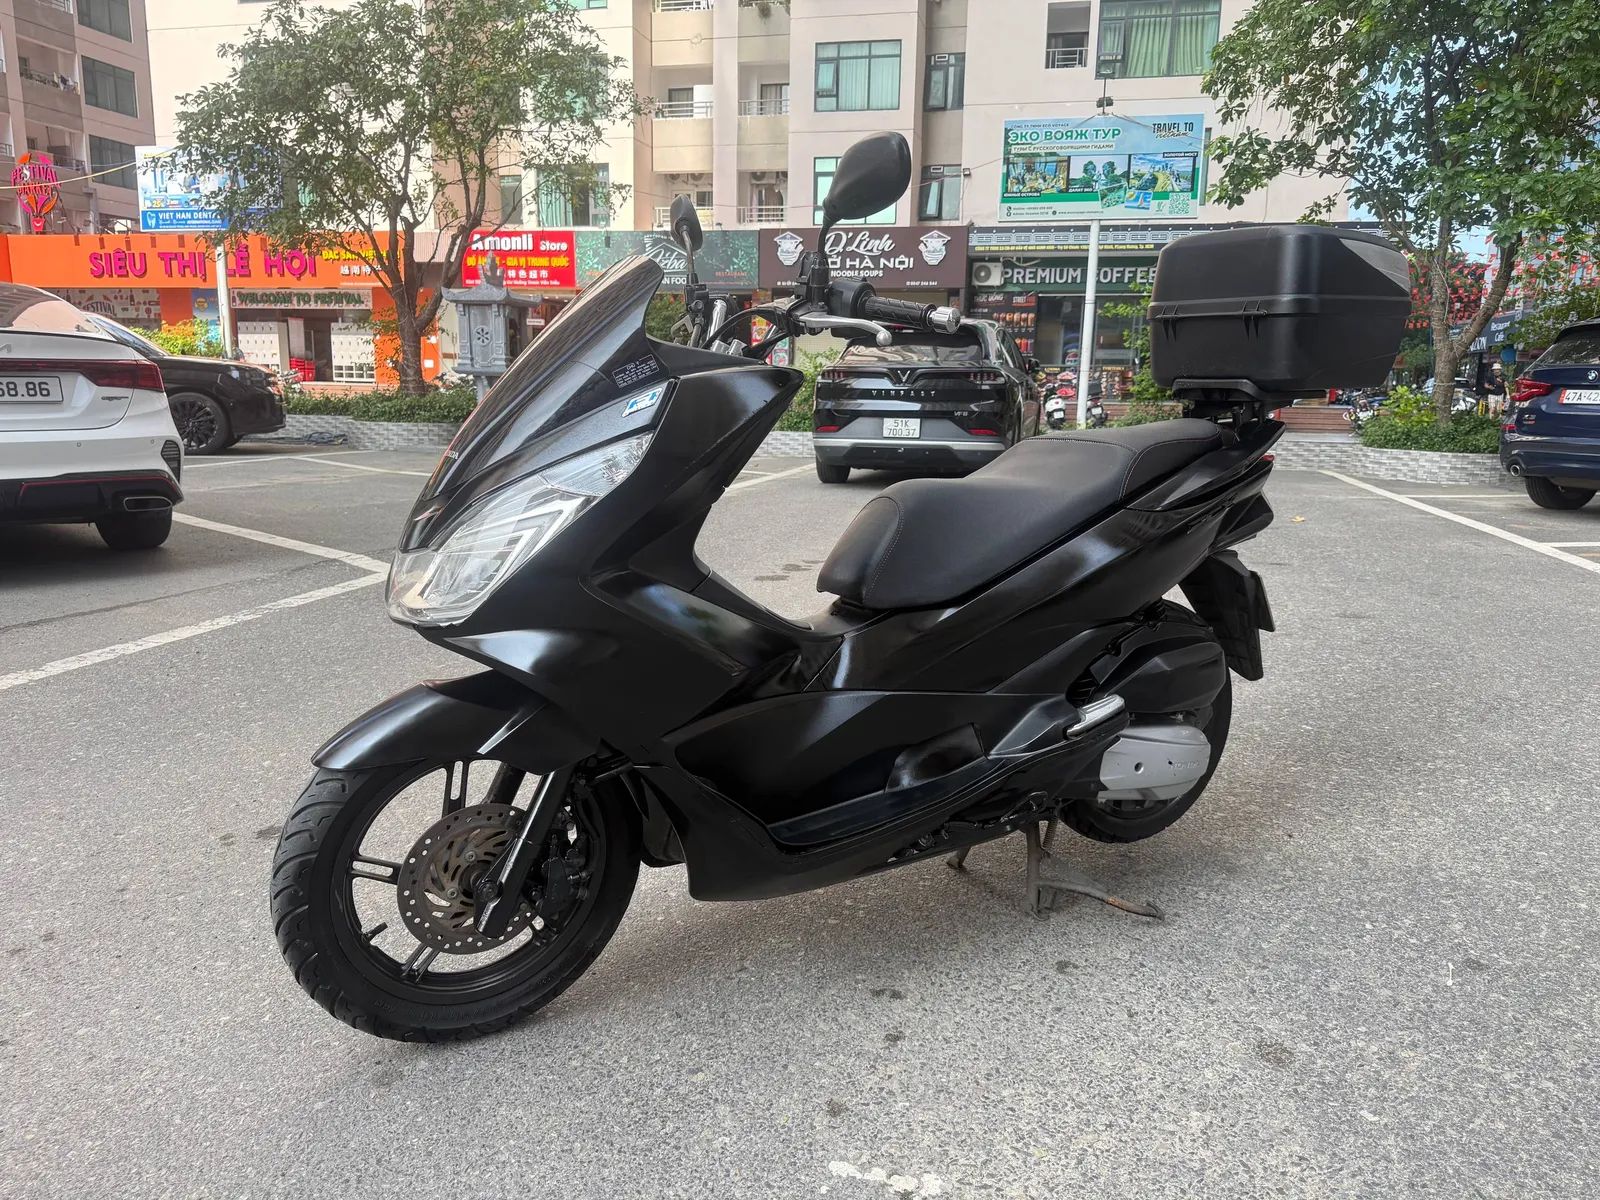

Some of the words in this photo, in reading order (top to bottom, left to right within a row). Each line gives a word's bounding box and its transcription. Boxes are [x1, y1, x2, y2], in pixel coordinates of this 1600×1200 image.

[1153, 122, 1180, 133] TRAVEL
[1184, 121, 1194, 132] TO
[1010, 131, 1040, 143] ЭКО
[1045, 129, 1088, 141] ВОЯЖ
[1093, 128, 1121, 139] ТУР
[158, 211, 173, 220] VIET
[176, 211, 191, 220] HAN
[471, 233, 534, 251] Amonli
[540, 240, 568, 251] Store
[824, 231, 895, 256] D'Linh
[90, 247, 148, 278] SIÊU
[158, 252, 206, 282] THỊ
[846, 255, 874, 269] HÀ
[879, 254, 914, 271] NỘI
[831, 269, 858, 279] NOODLE
[859, 269, 884, 279] SOUPS
[1003, 268, 1082, 285] PREMIUM
[236, 290, 292, 306] WELCOME
[296, 292, 311, 305] TO
[314, 291, 364, 305] FESTIVAL
[893, 419, 911, 429] 51K
[887, 427, 917, 438] 700.37
